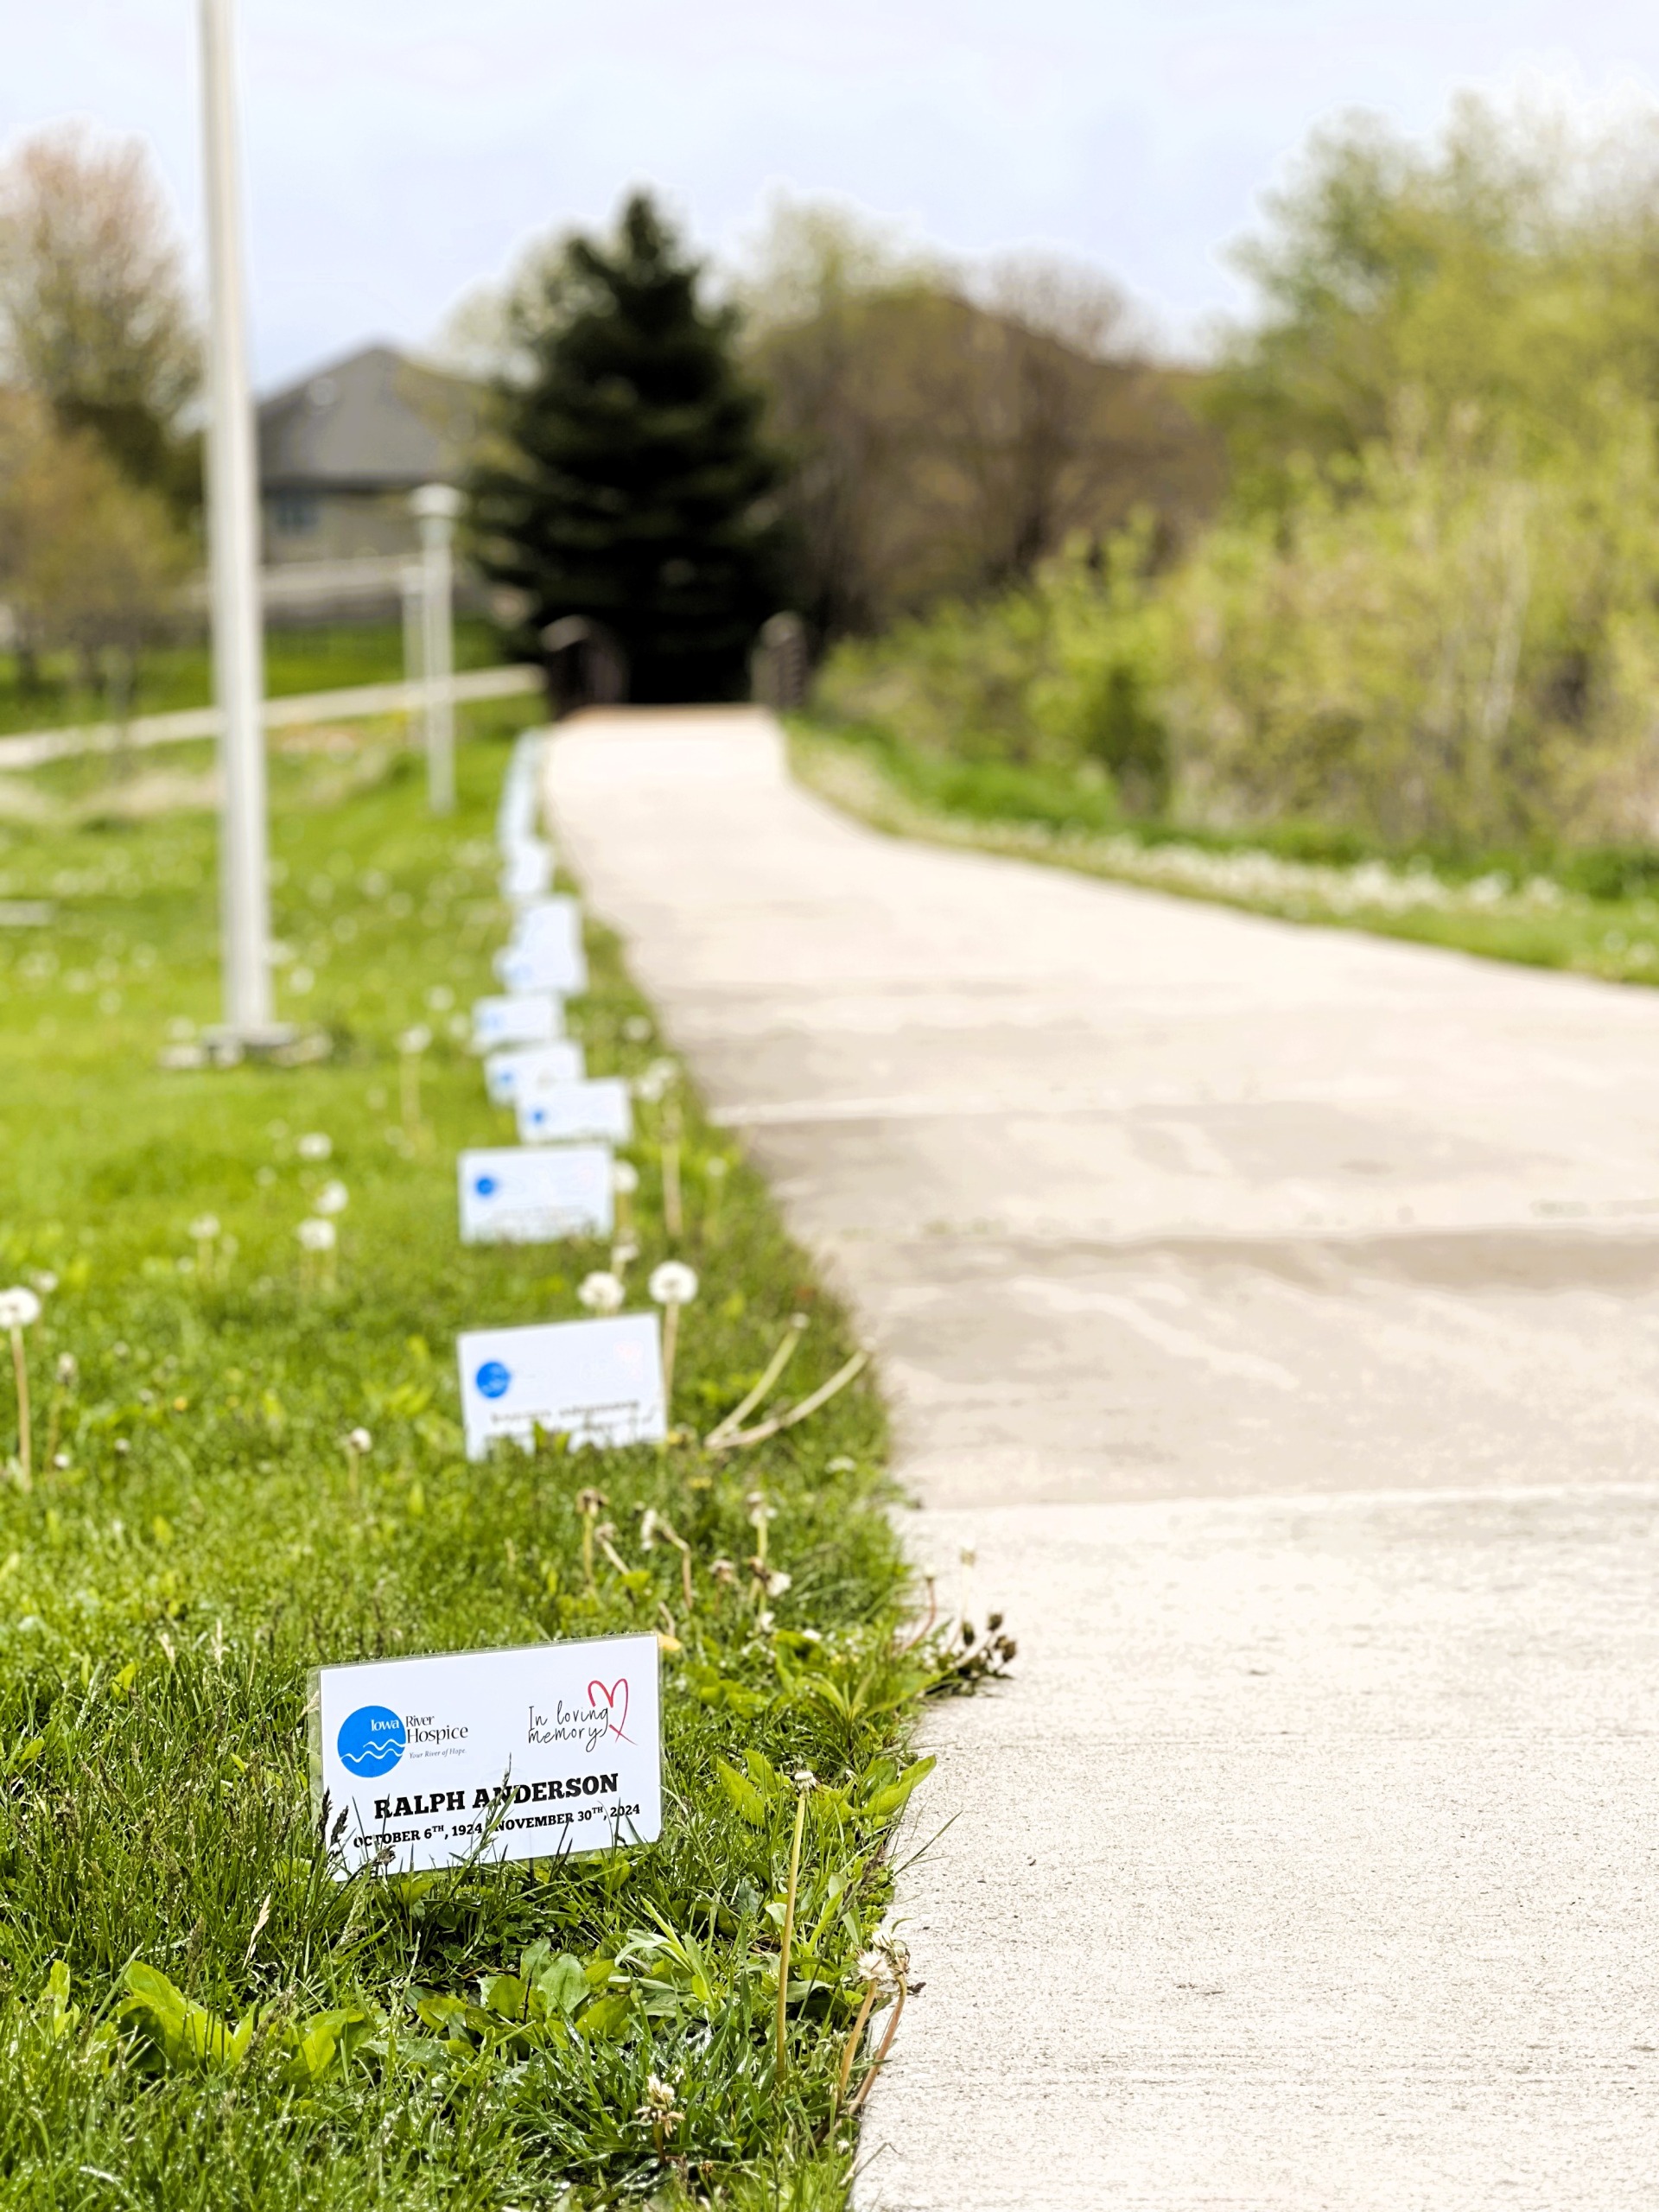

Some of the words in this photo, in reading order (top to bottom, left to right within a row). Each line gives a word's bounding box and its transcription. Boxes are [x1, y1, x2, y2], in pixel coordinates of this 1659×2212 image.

[371, 1719, 400, 1732] Iowa
[405, 1715, 435, 1727] River
[529, 1706, 548, 1730] In
[557, 1700, 608, 1738] loving
[407, 1725, 468, 1745] Hospice
[528, 1727, 600, 1752] memory
[442, 1748, 448, 1758] of
[374, 1790, 465, 1819] RALPH
[472, 1772, 619, 1809] ANDERSON
[353, 1830, 421, 1848] OCTOBER
[452, 1823, 482, 1837] 1924
[494, 1812, 575, 1832] NOVEMBER
[610, 1804, 640, 1818] 2024
